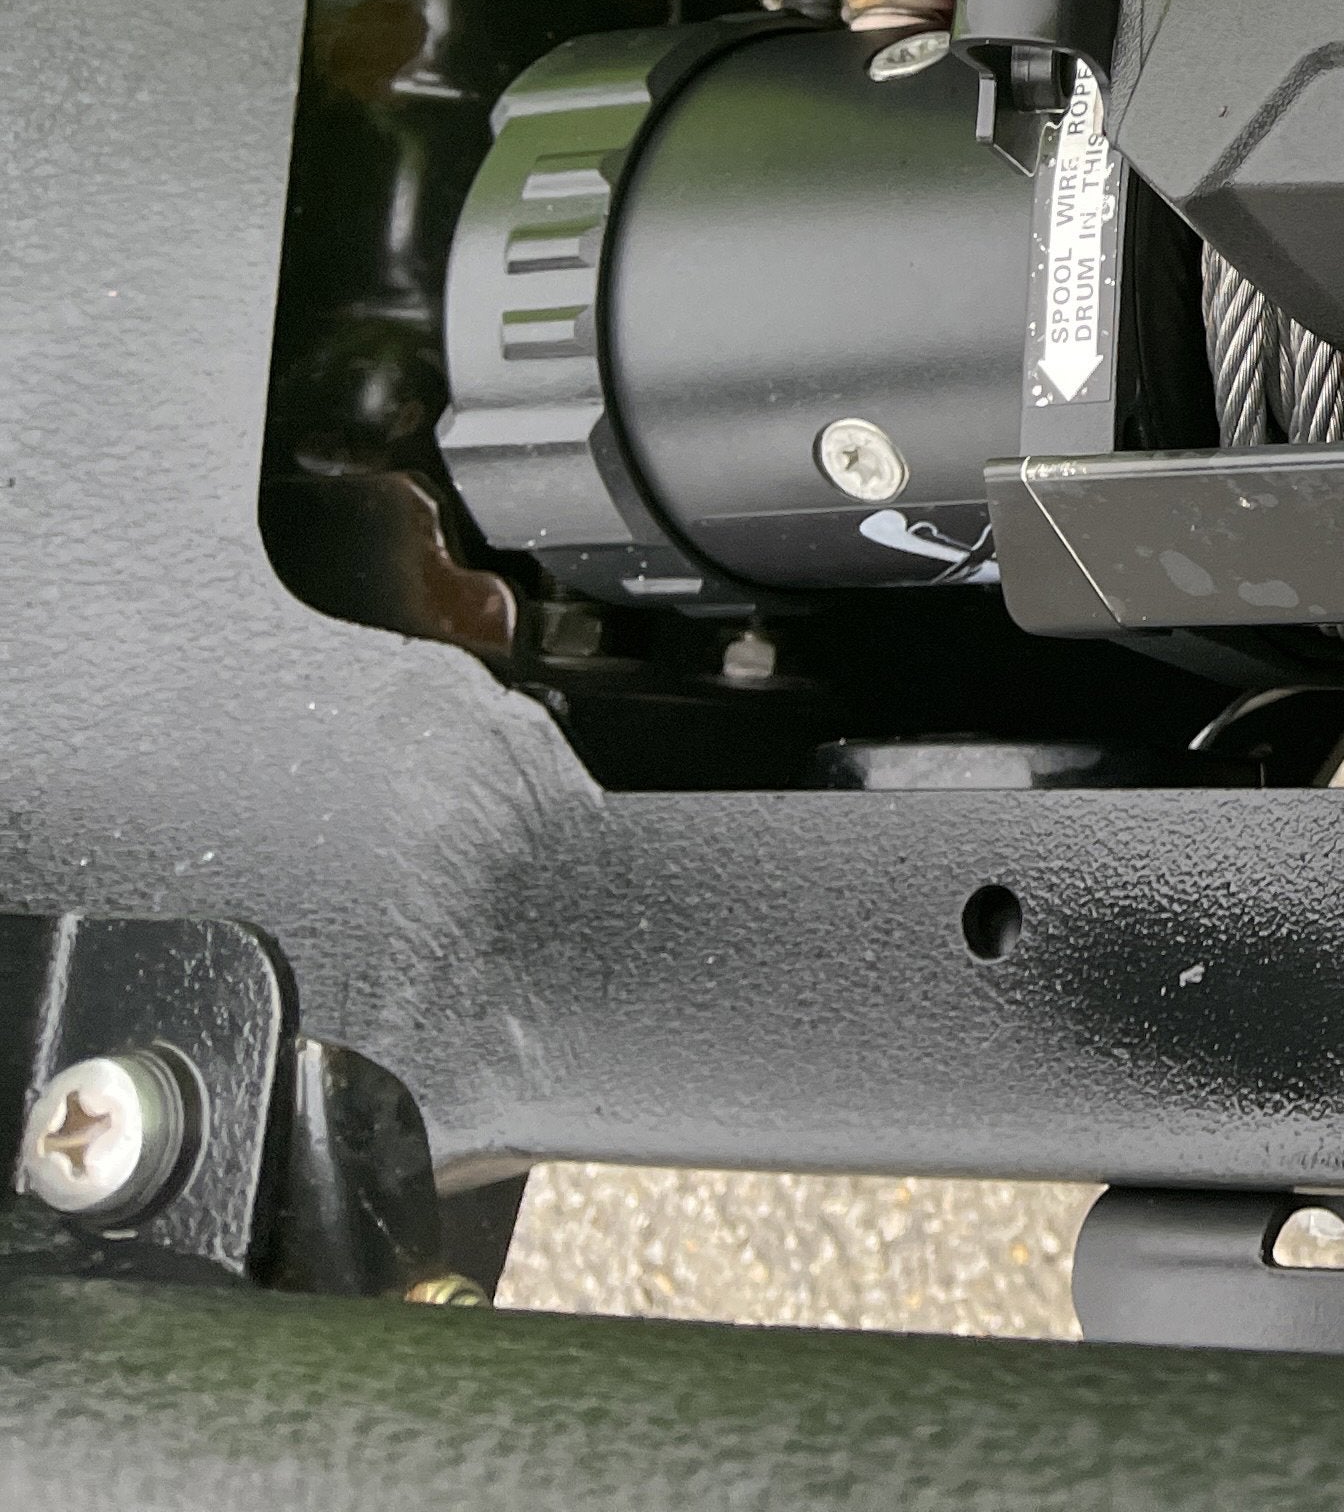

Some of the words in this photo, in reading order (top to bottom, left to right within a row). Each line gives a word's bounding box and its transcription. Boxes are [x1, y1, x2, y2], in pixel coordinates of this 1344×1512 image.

[1067, 64, 1092, 136] ROPE
[1056, 156, 1079, 227] WIRE
[1082, 133, 1107, 202] THIS
[1079, 211, 1098, 240] IN
[1051, 246, 1073, 344] SPOOL
[1075, 257, 1096, 342] DRUM
